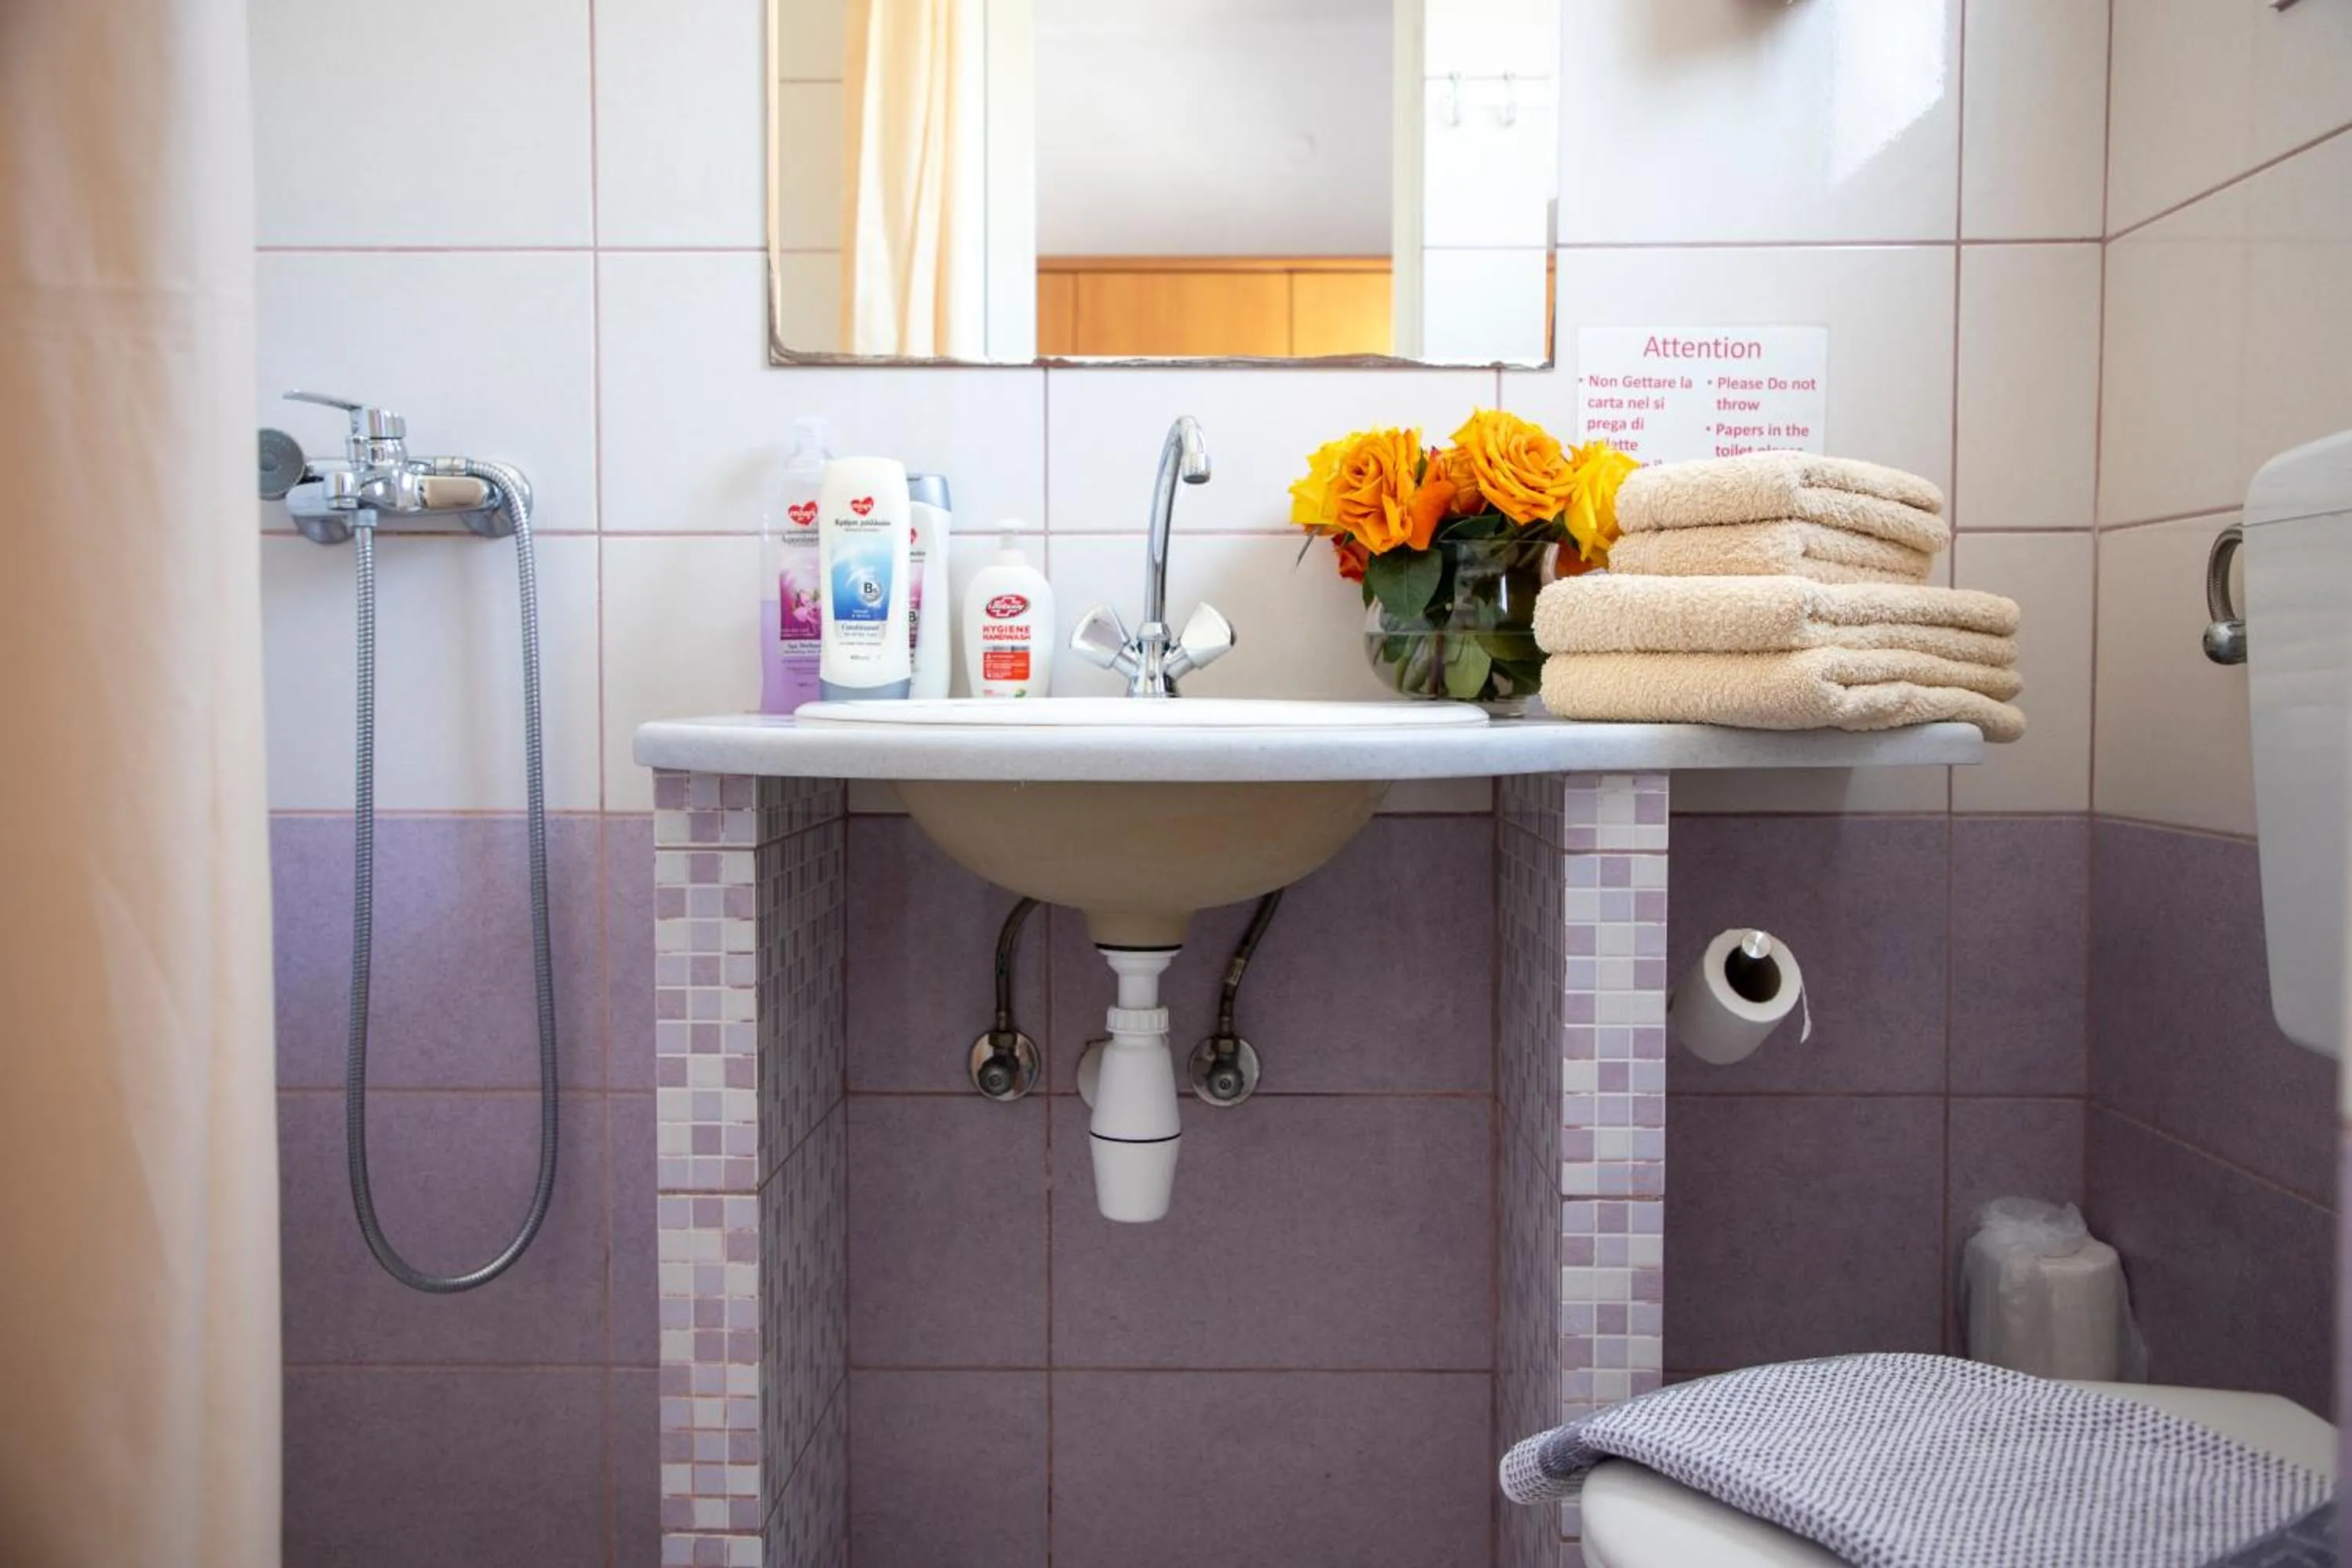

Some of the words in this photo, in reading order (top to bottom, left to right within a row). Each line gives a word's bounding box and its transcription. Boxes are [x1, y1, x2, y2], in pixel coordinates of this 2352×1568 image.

[1642, 336, 1762, 359] Attention
[1588, 376, 1618, 388] Non
[1621, 376, 1676, 389] Gettare
[1680, 376, 1693, 389] la
[1717, 376, 1764, 390] Please
[1768, 377, 1788, 390] Do
[1791, 379, 1817, 390] not
[1587, 397, 1624, 409] carta
[1627, 396, 1650, 409] nel
[1653, 396, 1665, 410] si
[1716, 397, 1761, 411] throw
[1587, 418, 1627, 432] prega
[1631, 417, 1645, 430] di
[1715, 423, 1764, 438] Papers
[1768, 423, 1782, 437] in
[1785, 423, 1809, 437] the
